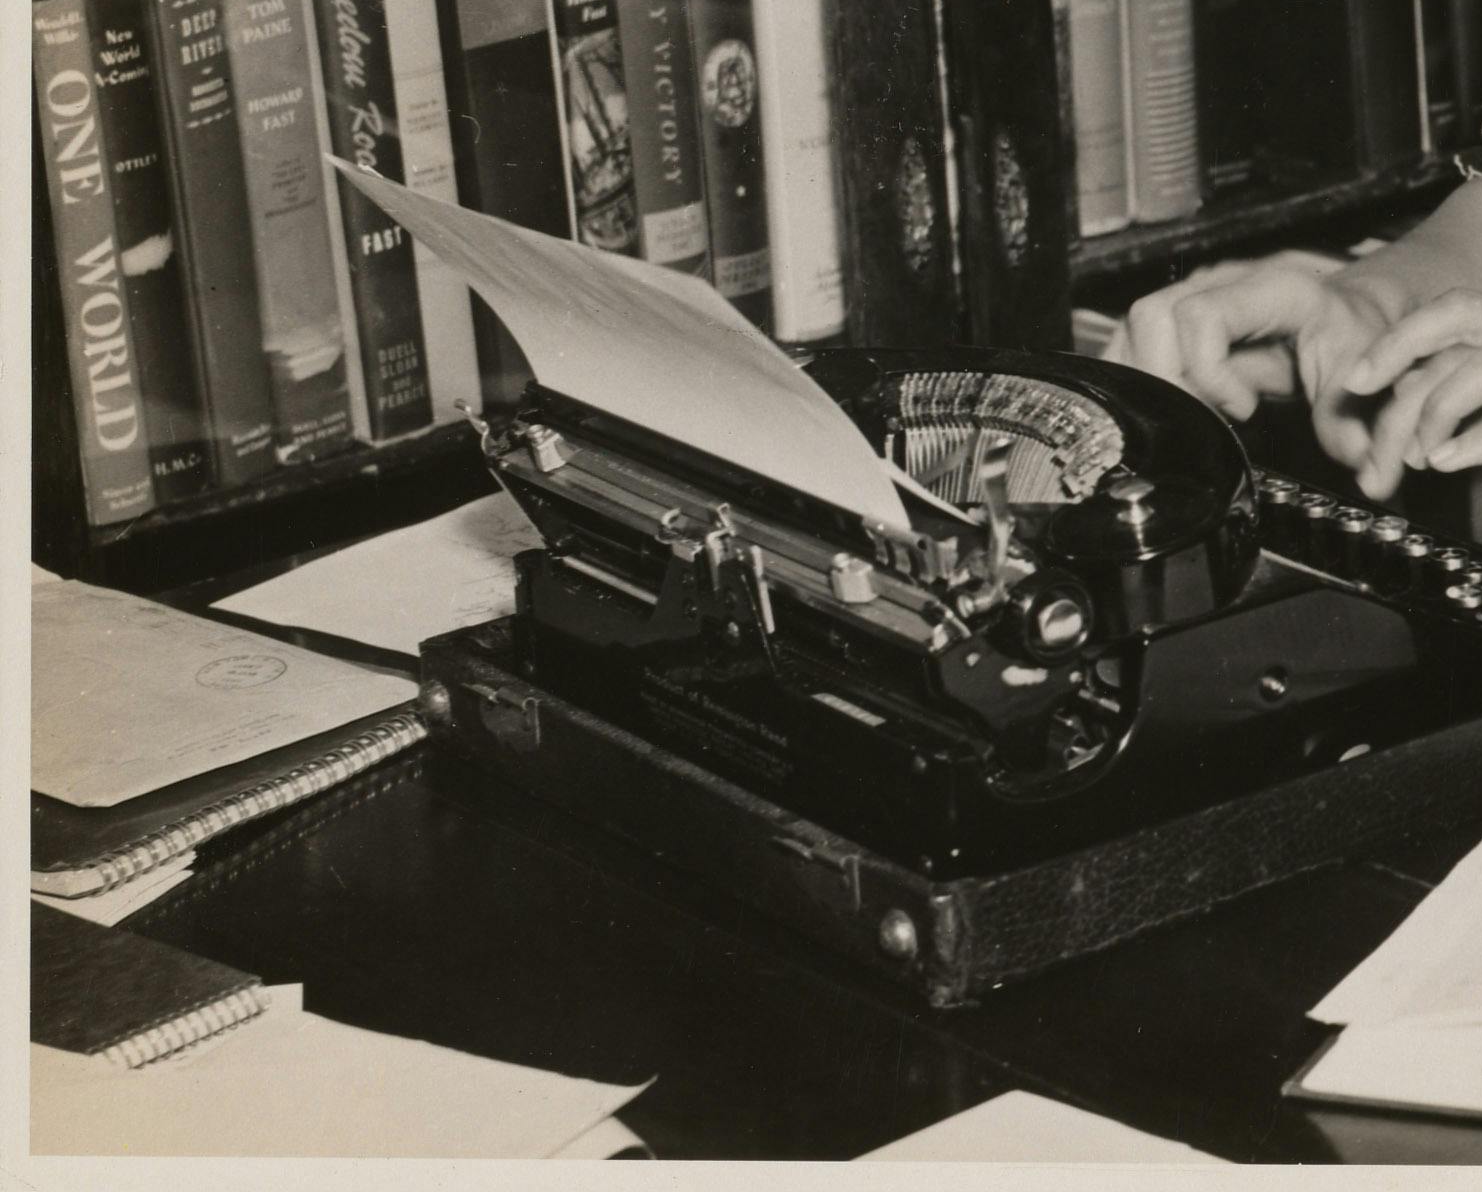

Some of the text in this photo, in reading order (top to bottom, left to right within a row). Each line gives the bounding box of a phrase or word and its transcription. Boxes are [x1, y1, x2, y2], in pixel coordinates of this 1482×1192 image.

[104, 28, 134, 45] New
[243, 17, 293, 45] PAINE
[99, 45, 141, 66] World
[247, 87, 304, 115] HOWARD
[654, 40, 683, 184] VICTORY
[262, 110, 296, 132] FAST
[362, 226, 401, 255] FAST
[46, 69, 140, 451] ONE WORLD
